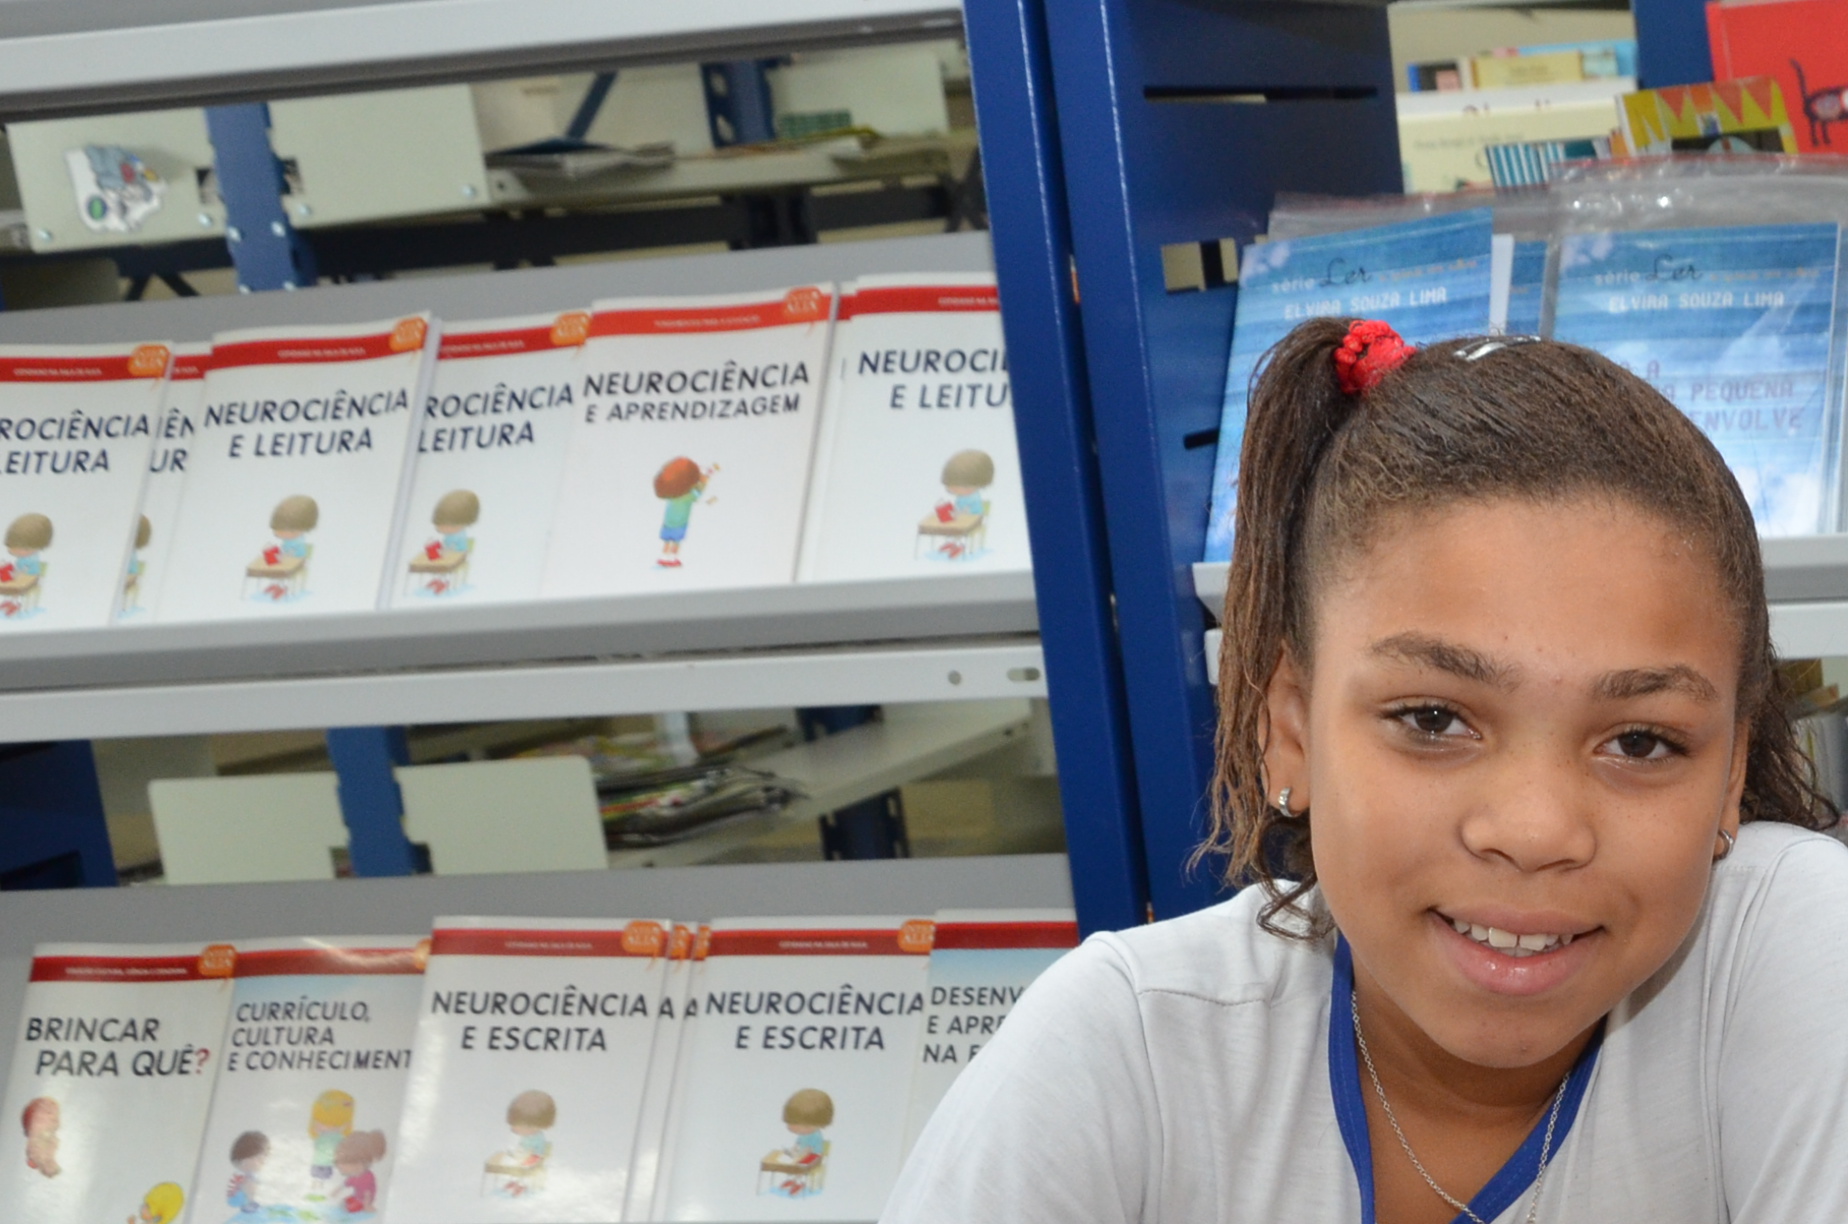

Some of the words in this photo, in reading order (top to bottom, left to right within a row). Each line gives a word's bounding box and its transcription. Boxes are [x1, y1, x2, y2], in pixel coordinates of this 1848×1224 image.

[1319, 257, 1372, 287] Ler
[1284, 299, 1341, 320] ELVIRA
[1350, 291, 1400, 312] SOUZA
[1410, 286, 1447, 306] LIMA
[1680, 291, 1734, 309] SOUZA
[1744, 291, 1785, 307] LIMA
[582, 359, 810, 397] NEUROCIÊNCIA
[1691, 379, 1795, 403] PEQUENA
[204, 388, 408, 427] NEUROCIÊNCIA
[585, 403, 598, 423] E
[606, 393, 801, 422] APRENDIZAGEM
[890, 383, 906, 409] E
[228, 434, 244, 458] E
[254, 427, 372, 457] LEITURA
[0, 448, 110, 474] EITURA
[236, 995, 371, 1023] CURRÍCULO,
[431, 984, 649, 1017] NEUROCIÊNCIA
[705, 984, 924, 1016] NEUROCIÊNCIA
[26, 1017, 160, 1042] BRINCAR
[232, 1026, 335, 1047] CULTURA
[927, 1015, 939, 1035] E
[461, 1026, 478, 1050] E
[487, 1026, 607, 1051] ESCRITA
[735, 1026, 751, 1050] E
[762, 1026, 885, 1051] ESCRITA
[35, 1050, 119, 1076] PARA
[131, 1044, 210, 1077] QUÊ?
[227, 1052, 240, 1071] E
[923, 1044, 957, 1063] NA
